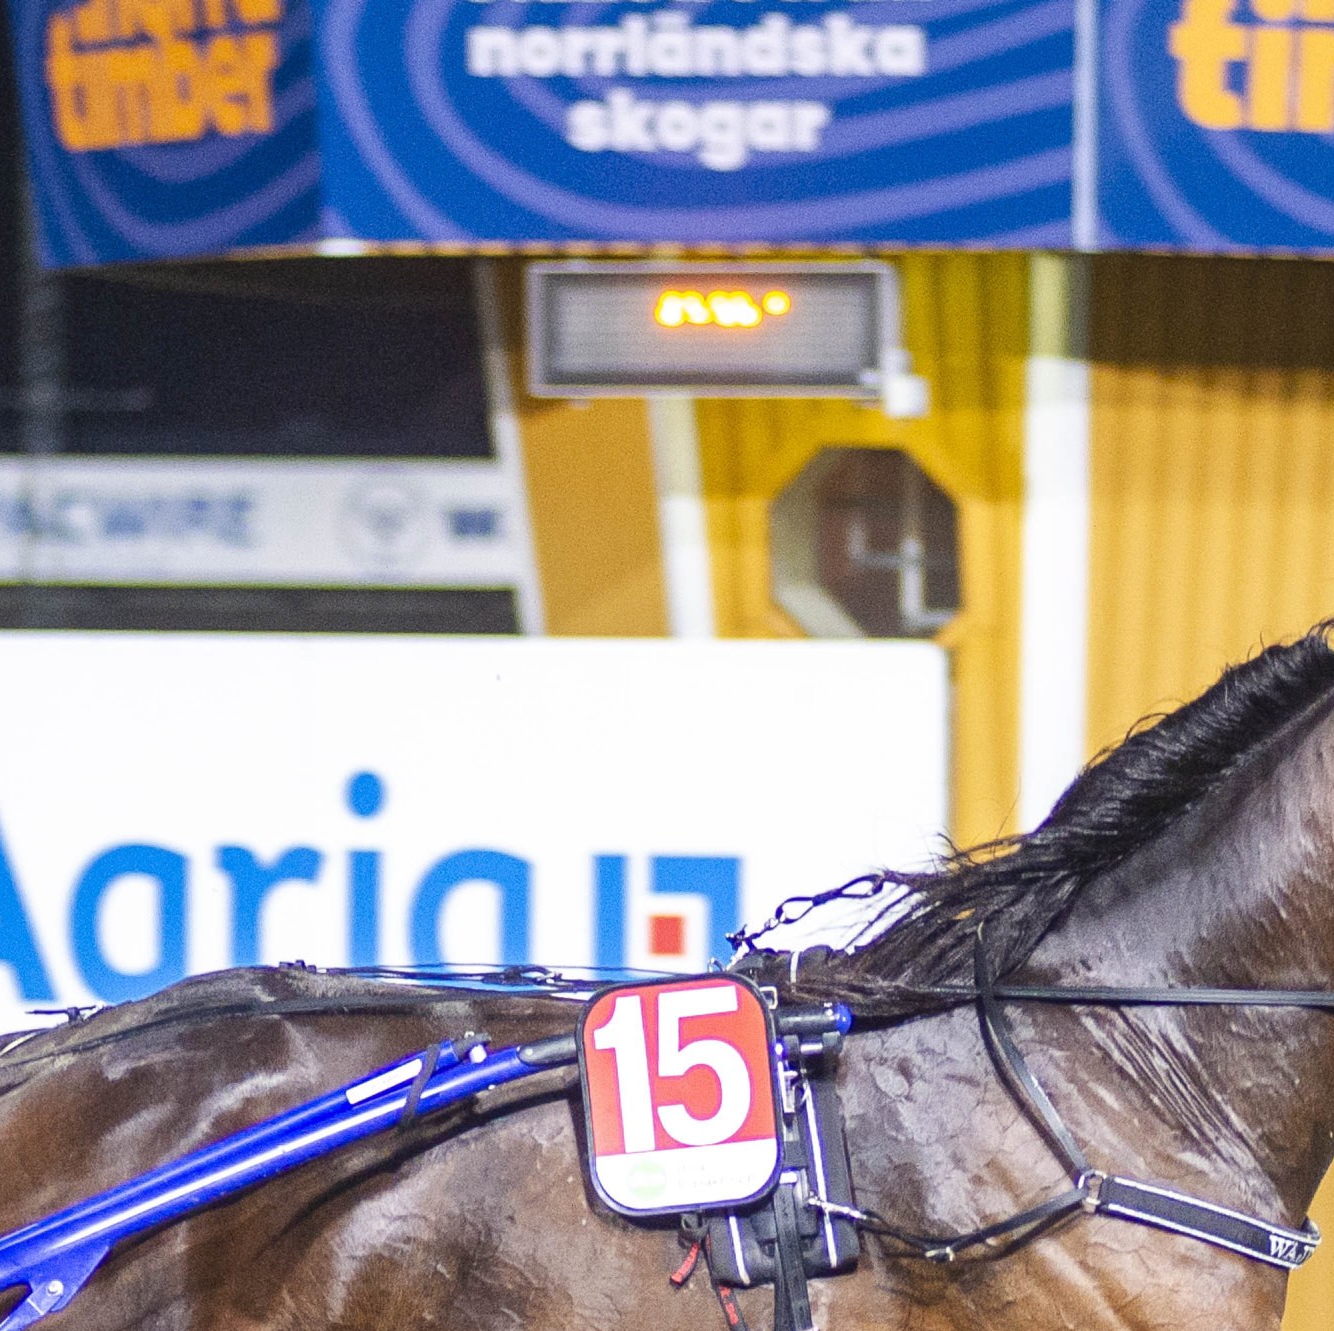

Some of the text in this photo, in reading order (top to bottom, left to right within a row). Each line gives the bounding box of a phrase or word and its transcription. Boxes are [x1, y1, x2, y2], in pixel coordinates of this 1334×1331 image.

[468, 10, 929, 79] norrländska
[568, 86, 831, 172] skogar
[593, 985, 752, 1154] 15
